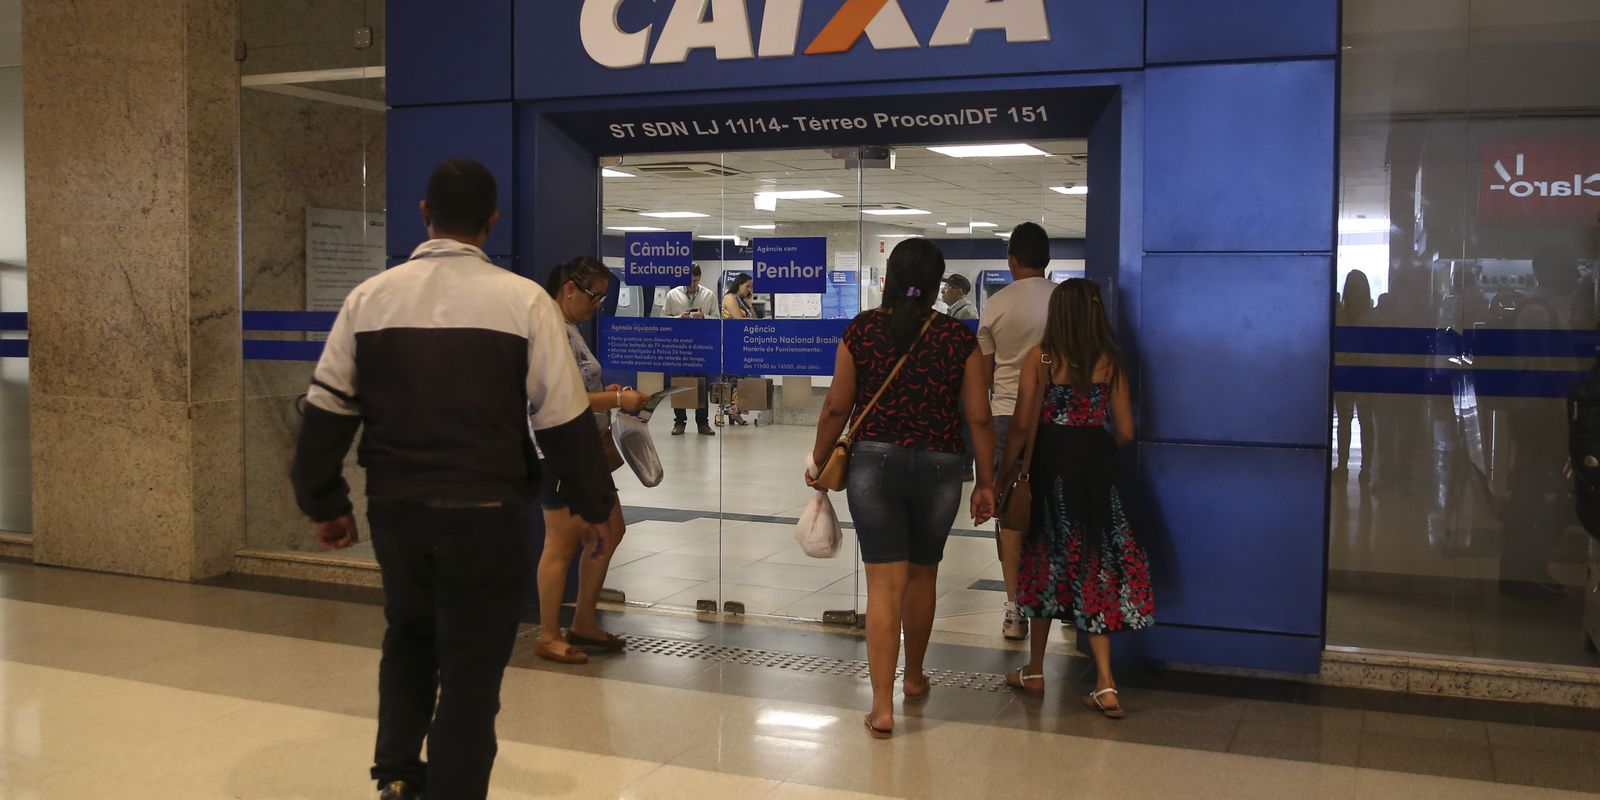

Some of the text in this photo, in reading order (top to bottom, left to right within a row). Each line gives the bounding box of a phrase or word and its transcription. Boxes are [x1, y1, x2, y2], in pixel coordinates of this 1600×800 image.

[579, 0, 1052, 69] CAIXA
[609, 105, 1048, 140] ST SDN LJ 11/14- Térreo Procon/DF 151
[630, 241, 690, 257] Câmbio
[756, 245, 783, 254] Agência
[630, 261, 690, 277] Exchange
[756, 260, 823, 279] Penhor
[611, 324, 633, 332] Agência
[743, 325, 776, 335] Agência
[743, 335, 778, 345] Conjunto
[779, 335, 815, 344] Nacional
